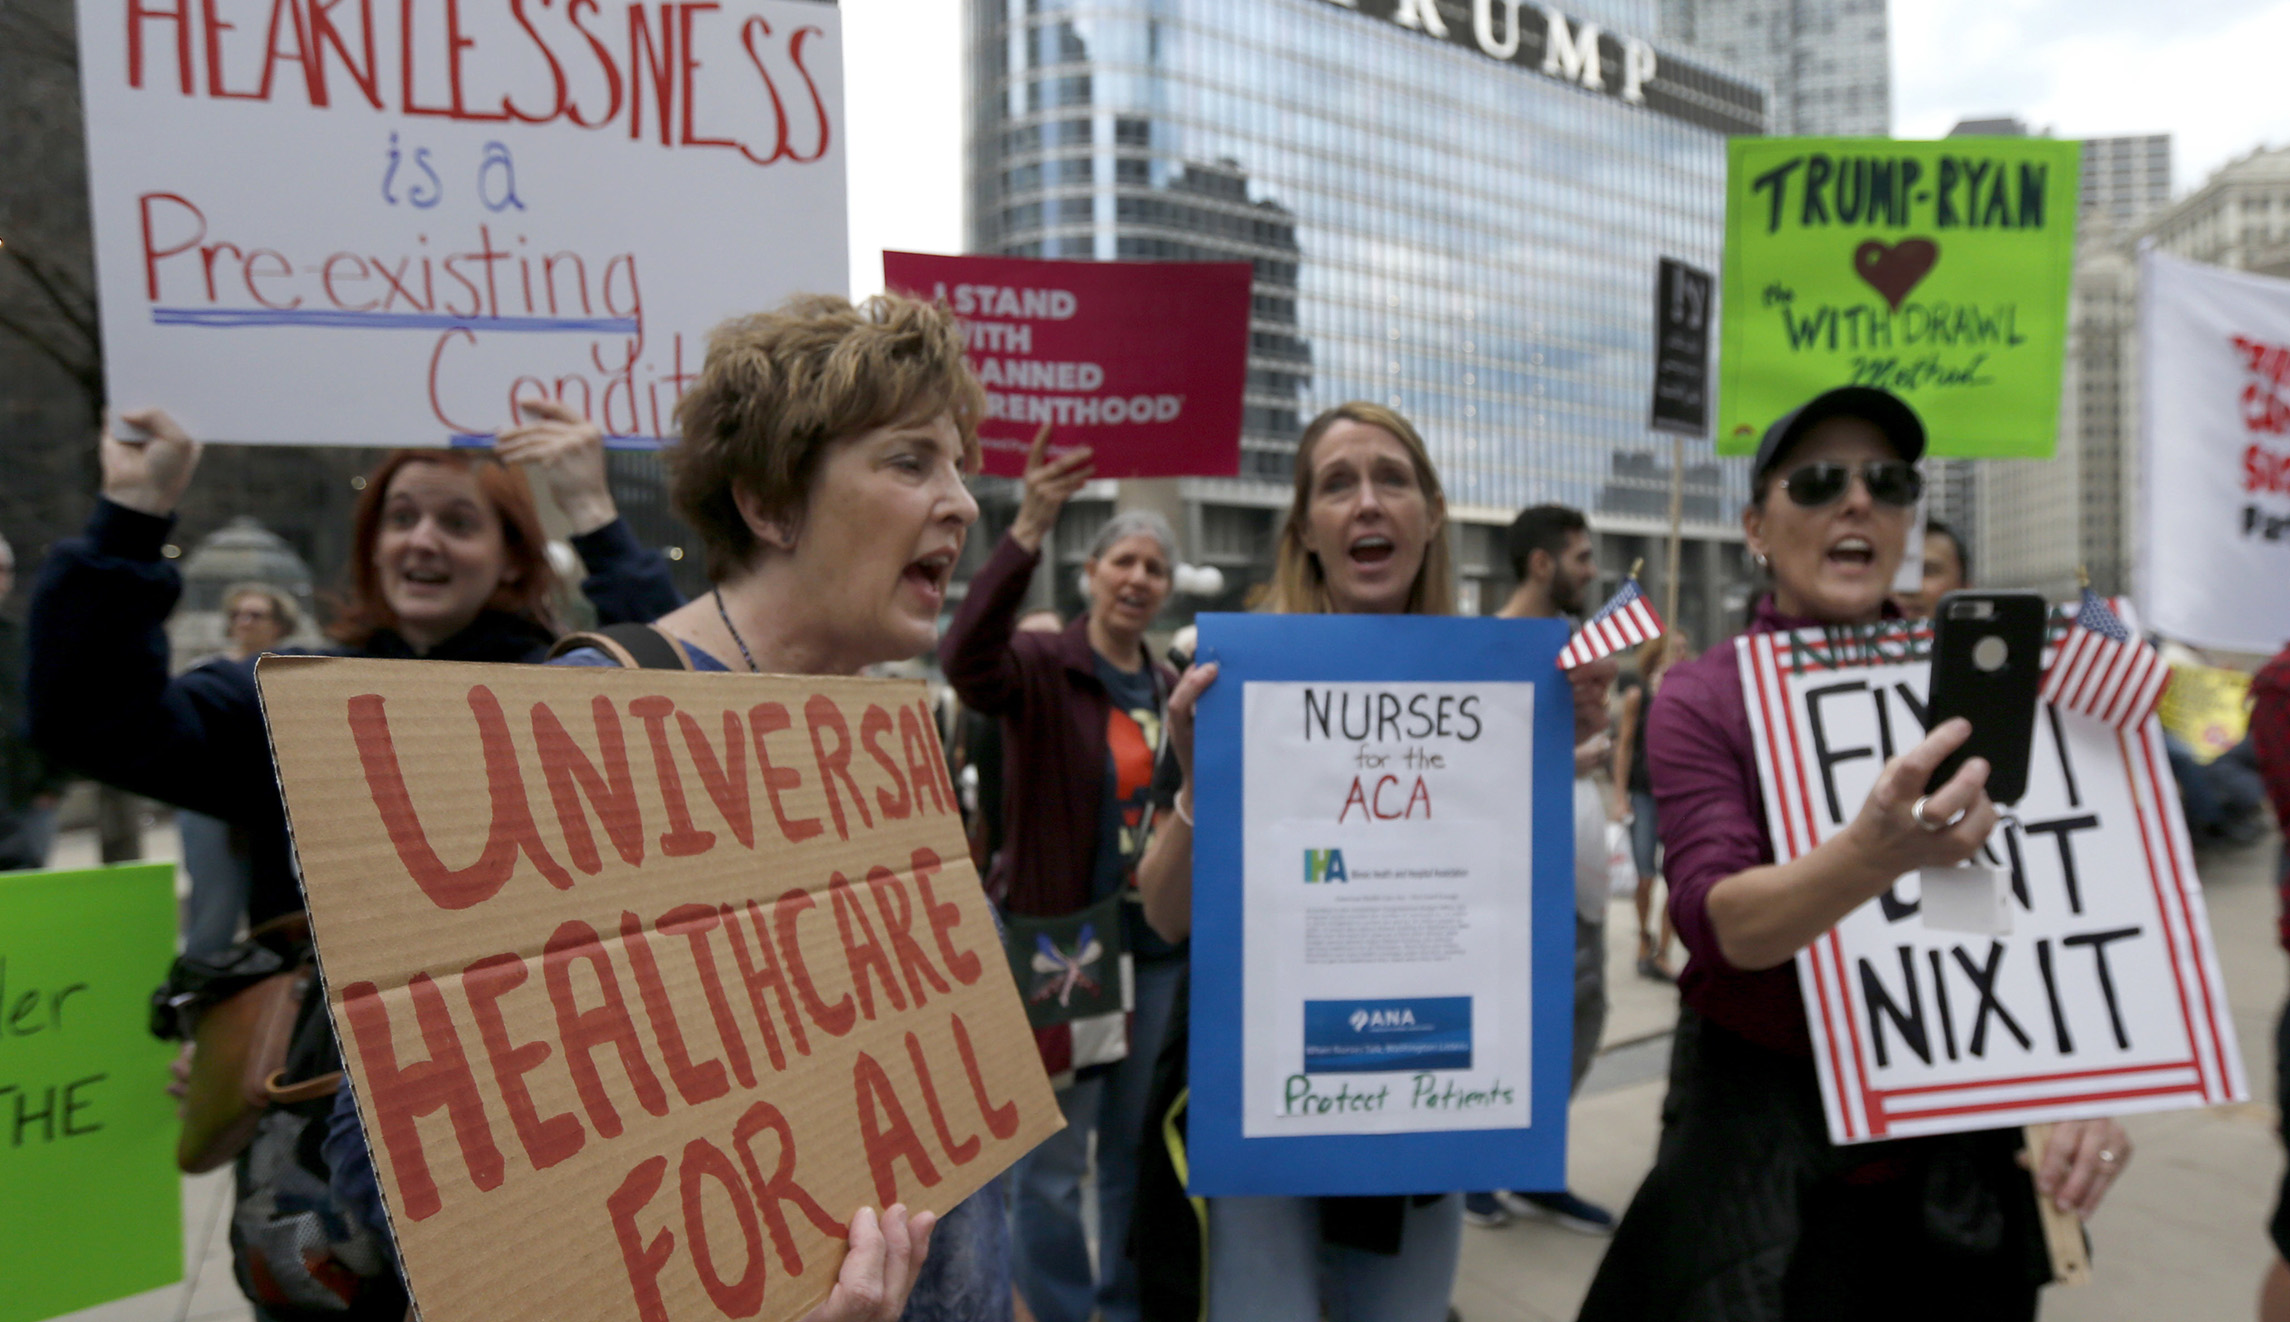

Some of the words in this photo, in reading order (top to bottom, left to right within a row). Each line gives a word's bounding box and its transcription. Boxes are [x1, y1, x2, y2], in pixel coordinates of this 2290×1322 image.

[1336, 0, 1657, 104] RUMP
[381, 132, 442, 208] is
[478, 140, 527, 211] a
[1753, 153, 2047, 234] TRUMP-RYAN
[138, 192, 643, 375] Pre-existing
[954, 283, 1077, 320] STAND
[961, 357, 1105, 392] ANNED
[984, 391, 1182, 426] RENTHOOD
[1304, 689, 1482, 742] NURSES
[1354, 745, 1390, 769] for
[1403, 747, 1446, 769] the
[347, 684, 961, 909] UNIVERSAL
[1338, 774, 1431, 824] ACA
[1370, 1009, 1416, 1027] ANA
[1858, 940, 2034, 1069] NIX
[2036, 928, 2143, 1056] IT
[343, 847, 982, 1222] HEALTHCARE
[1284, 1074, 1390, 1115] Protect
[1411, 1070, 1515, 1110] Patients
[607, 1100, 850, 1322] FOR
[853, 1013, 1019, 1209] ALL
